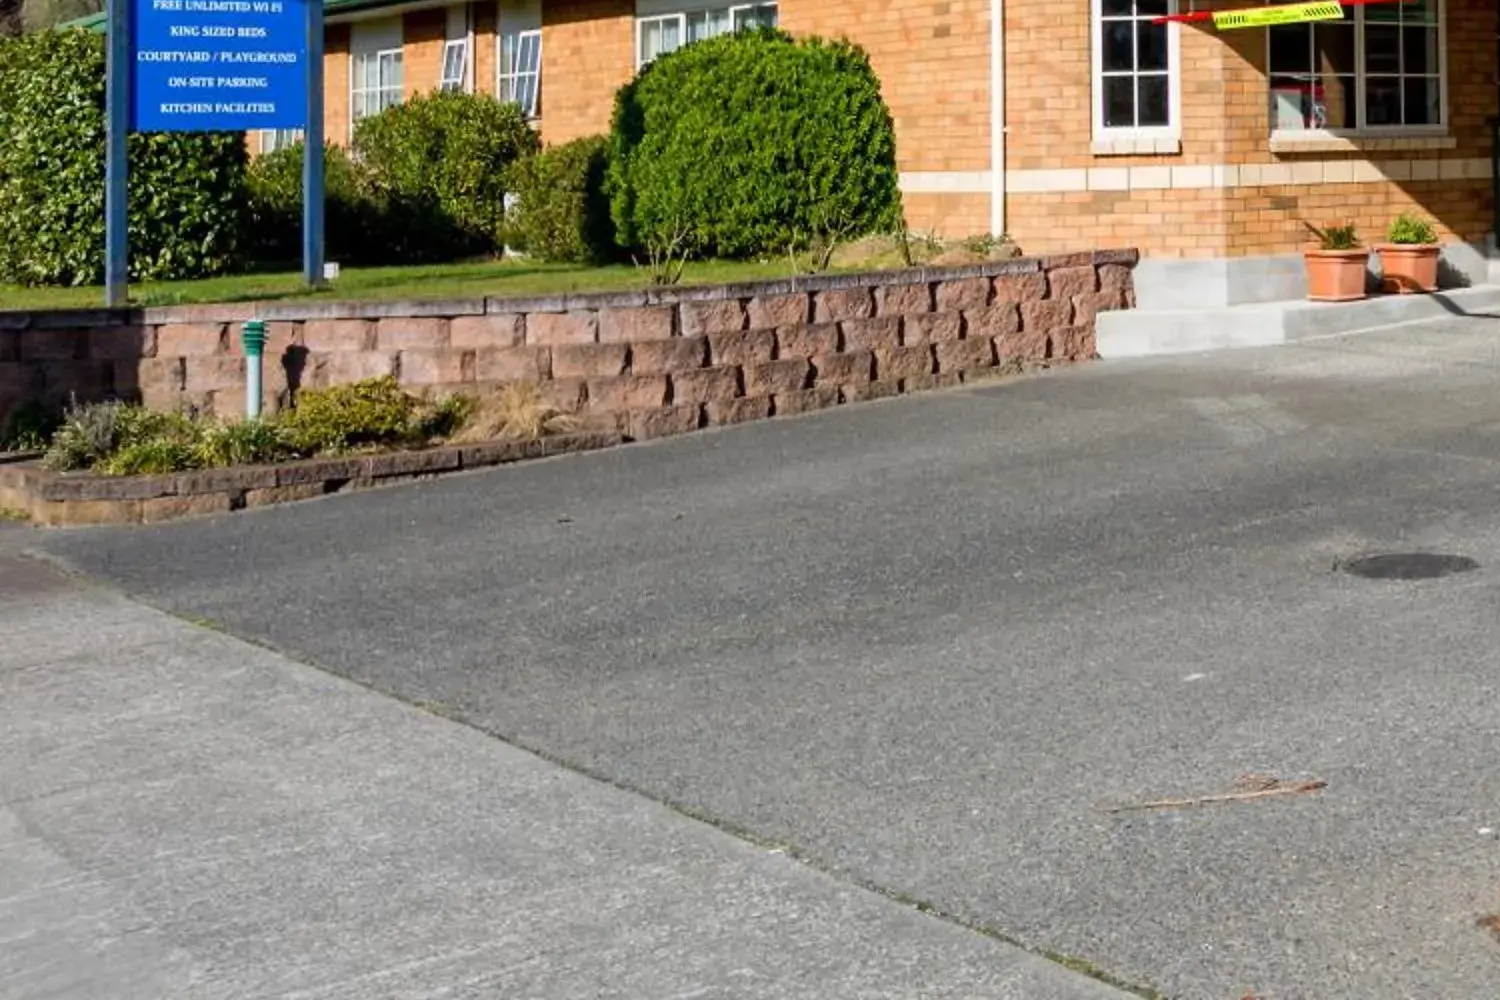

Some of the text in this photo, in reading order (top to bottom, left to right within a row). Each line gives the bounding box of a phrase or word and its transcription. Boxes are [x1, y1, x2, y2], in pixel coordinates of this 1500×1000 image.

[153, 0, 183, 11] FREE
[185, 0, 251, 12] UNLIMITED
[171, 26, 267, 37] KING SIZED BEDS
[137, 51, 211, 62] COURTYARD
[221, 52, 297, 63] PLAYGROUND
[168, 76, 268, 88] ON-SITE PARKING
[160, 103, 275, 114] KITCHEN FACILITIES
